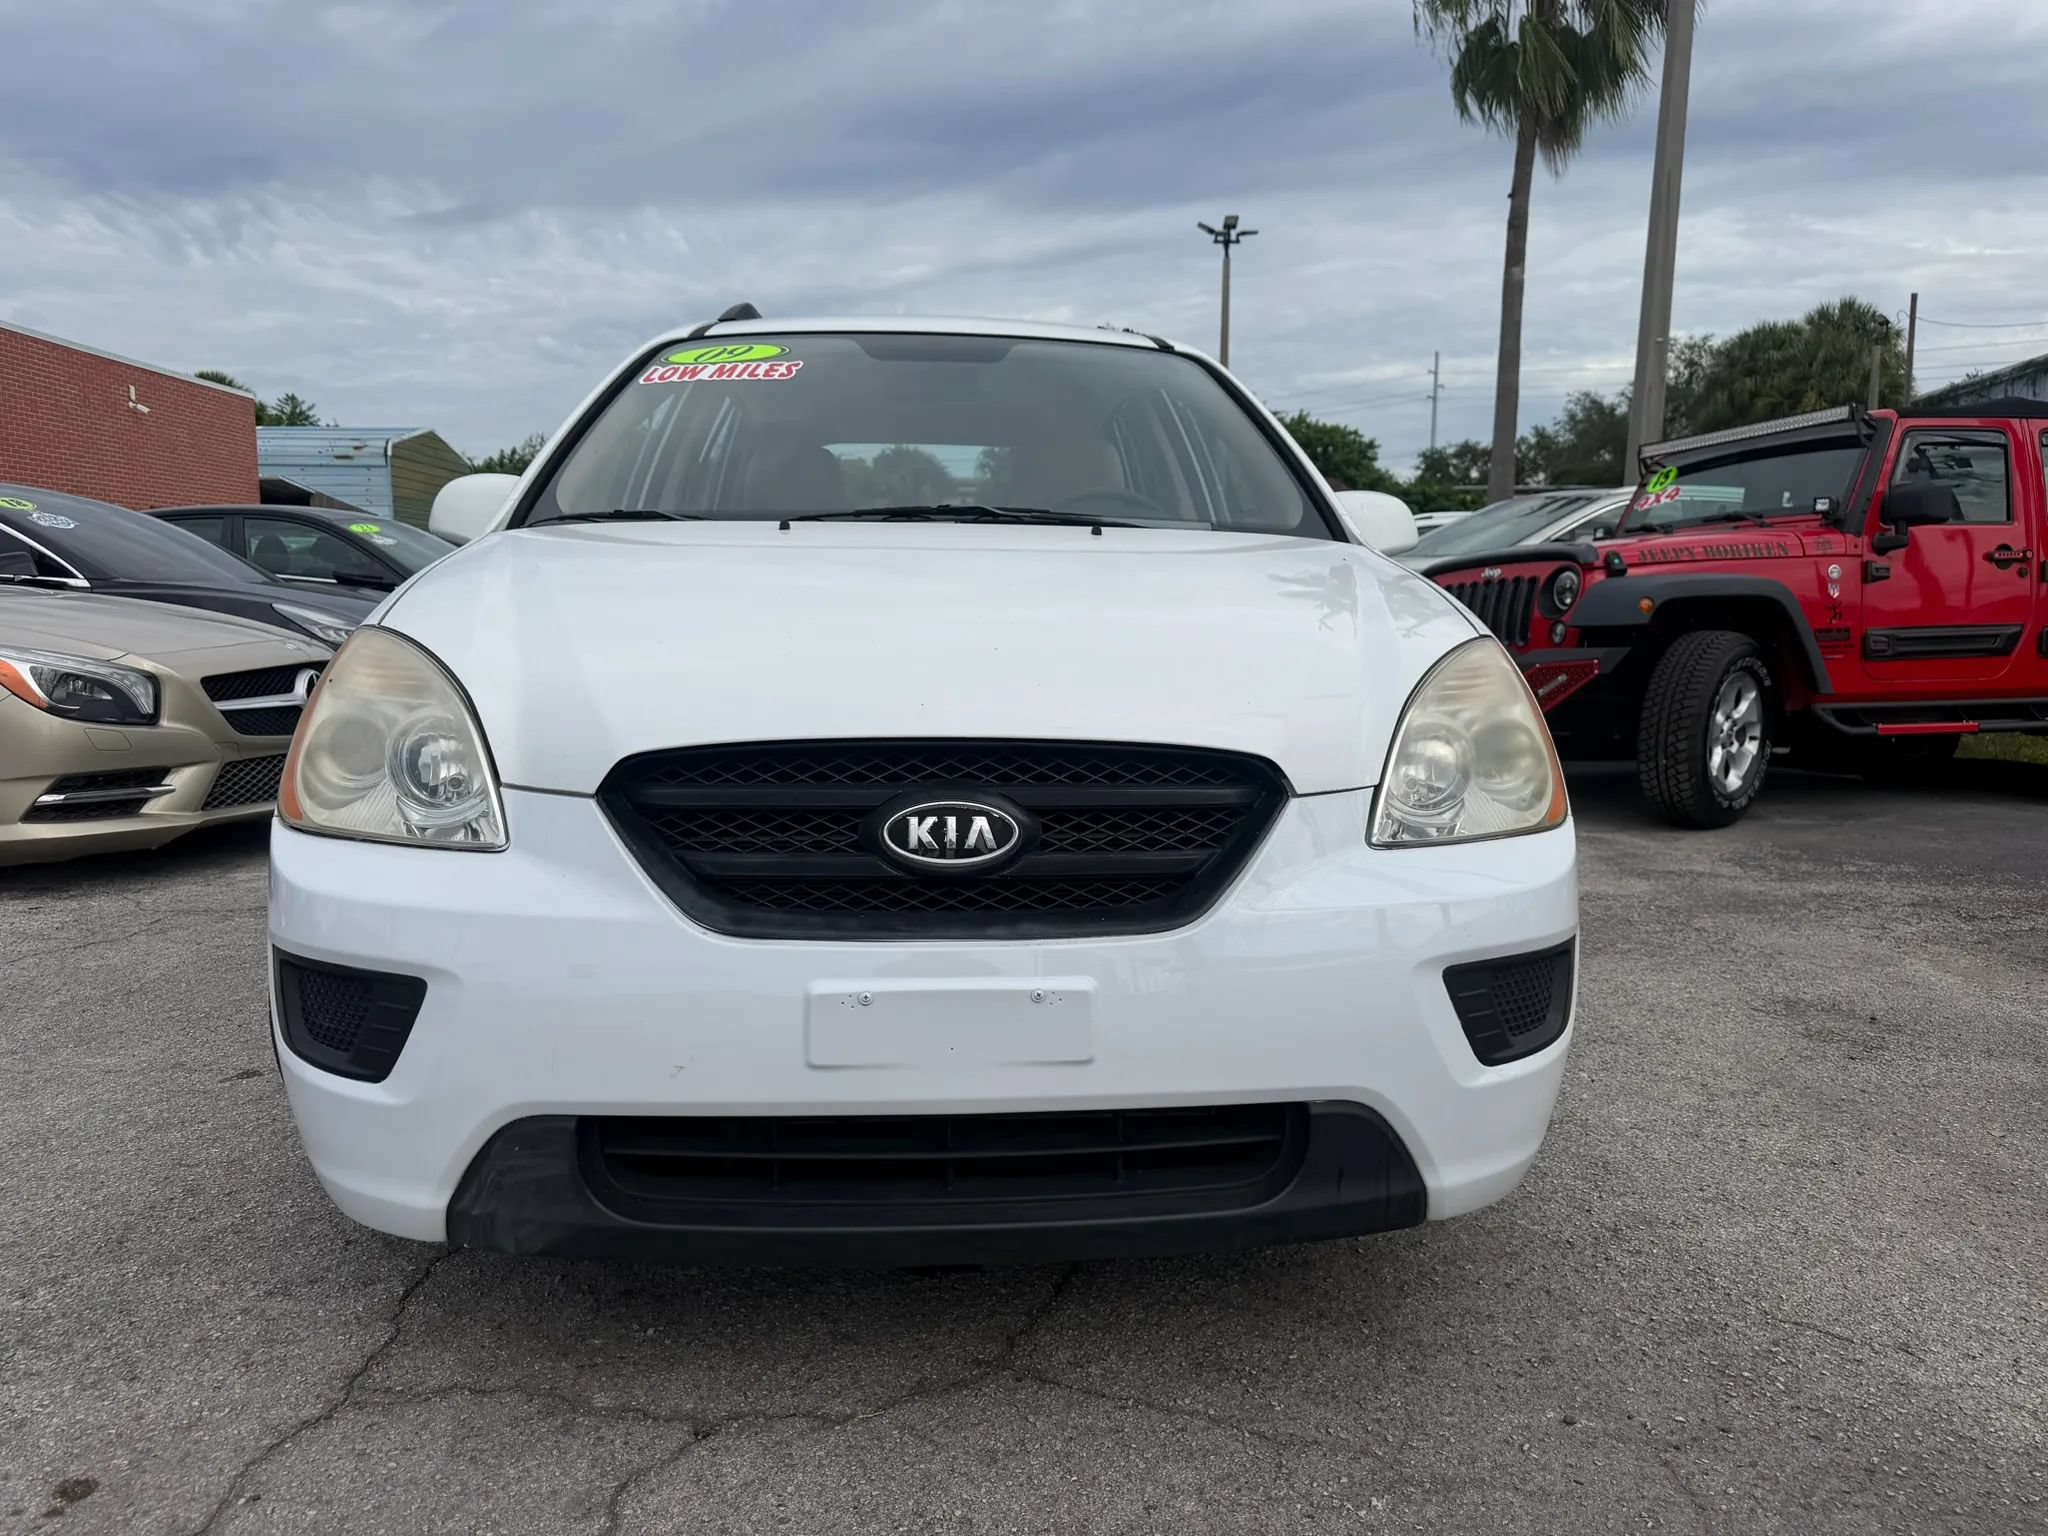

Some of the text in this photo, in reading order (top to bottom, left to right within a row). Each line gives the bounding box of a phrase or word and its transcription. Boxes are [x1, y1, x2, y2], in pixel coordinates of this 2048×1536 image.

[694, 345, 754, 362] 09
[643, 363, 799, 382] LOW MILES
[1651, 468, 1673, 488] 15
[906, 816, 998, 850] KIA
